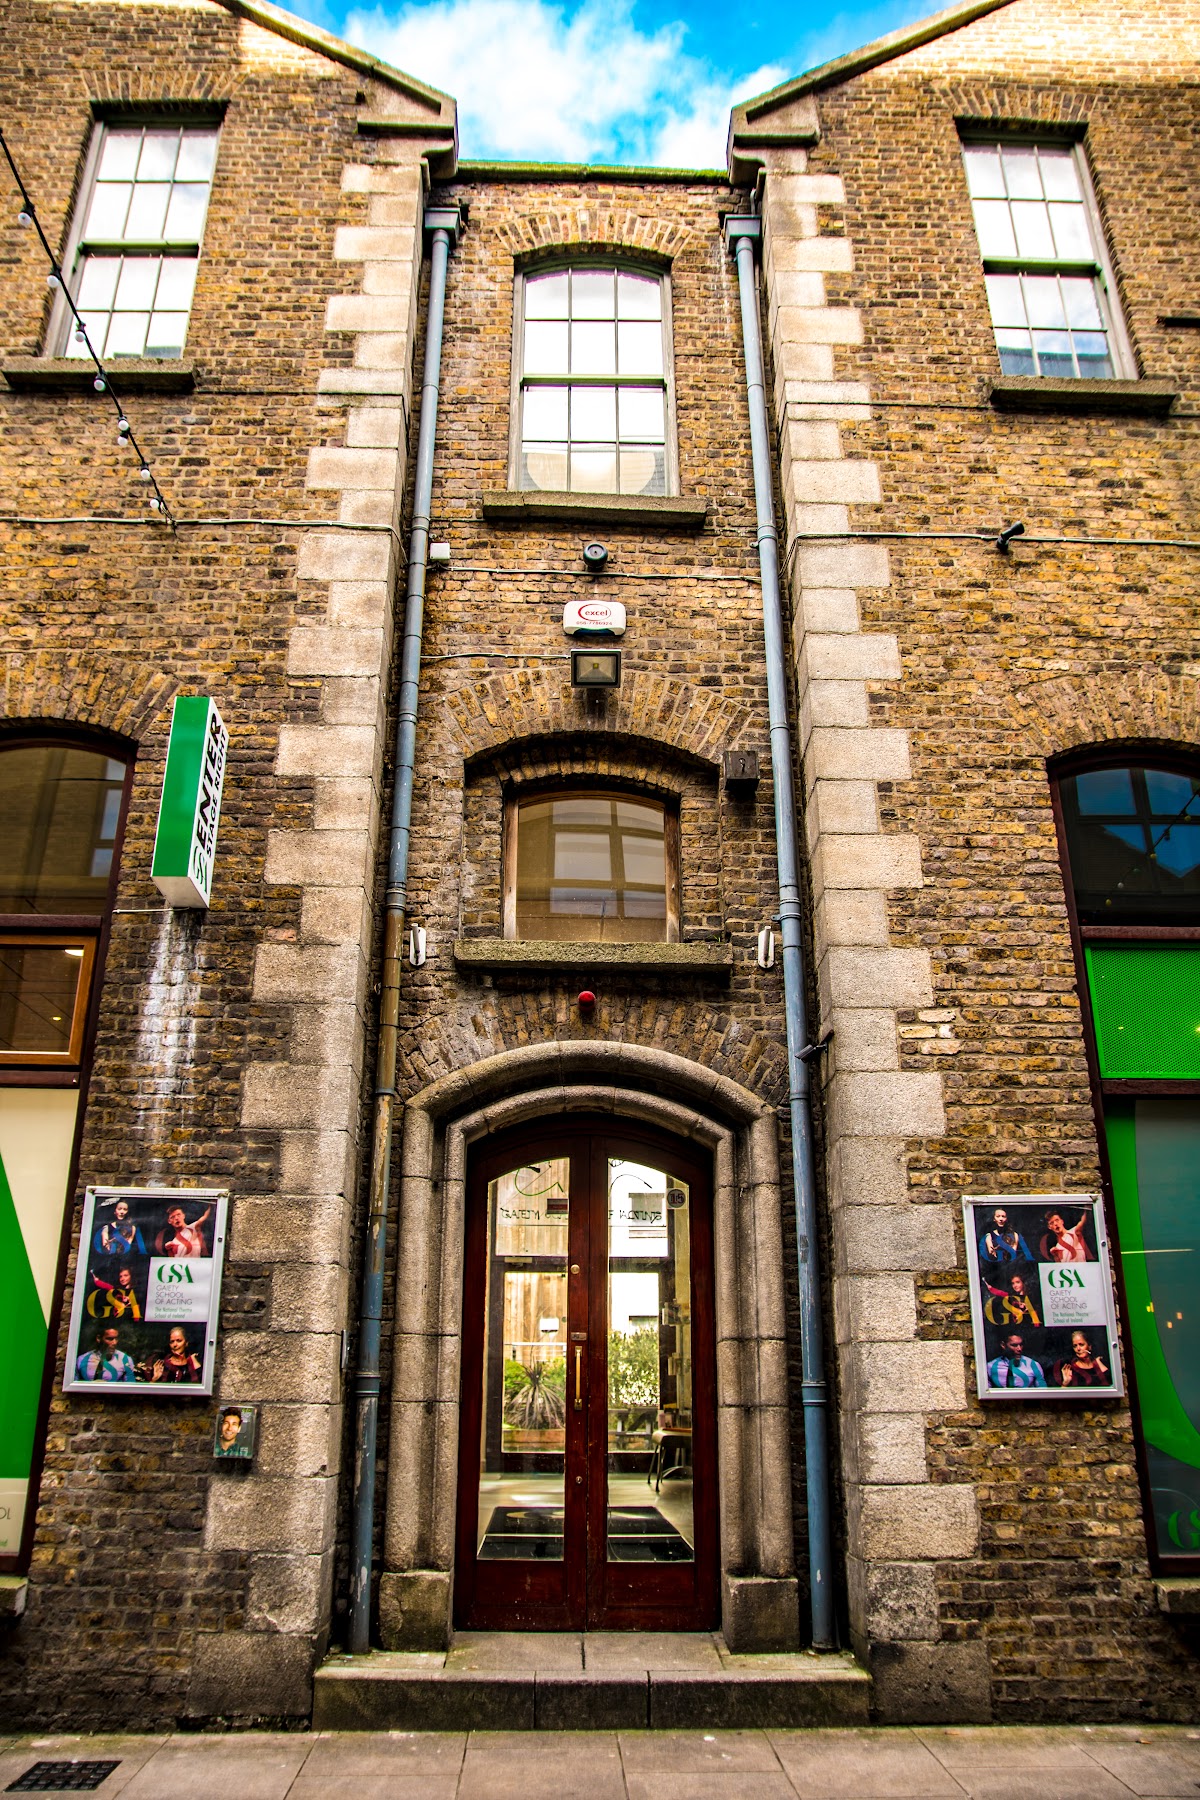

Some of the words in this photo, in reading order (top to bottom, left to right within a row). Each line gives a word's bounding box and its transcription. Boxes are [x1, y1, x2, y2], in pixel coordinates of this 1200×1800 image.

[196, 712, 222, 850] ENTER
[207, 798, 218, 858] STAGE
[215, 730, 226, 791] RIGHT
[979, 1233, 1035, 1262] GSA
[157, 1264, 194, 1284] GSA
[1048, 1269, 1085, 1288] GSA
[86, 1288, 143, 1319] GSA
[984, 1295, 1042, 1326] GSA
